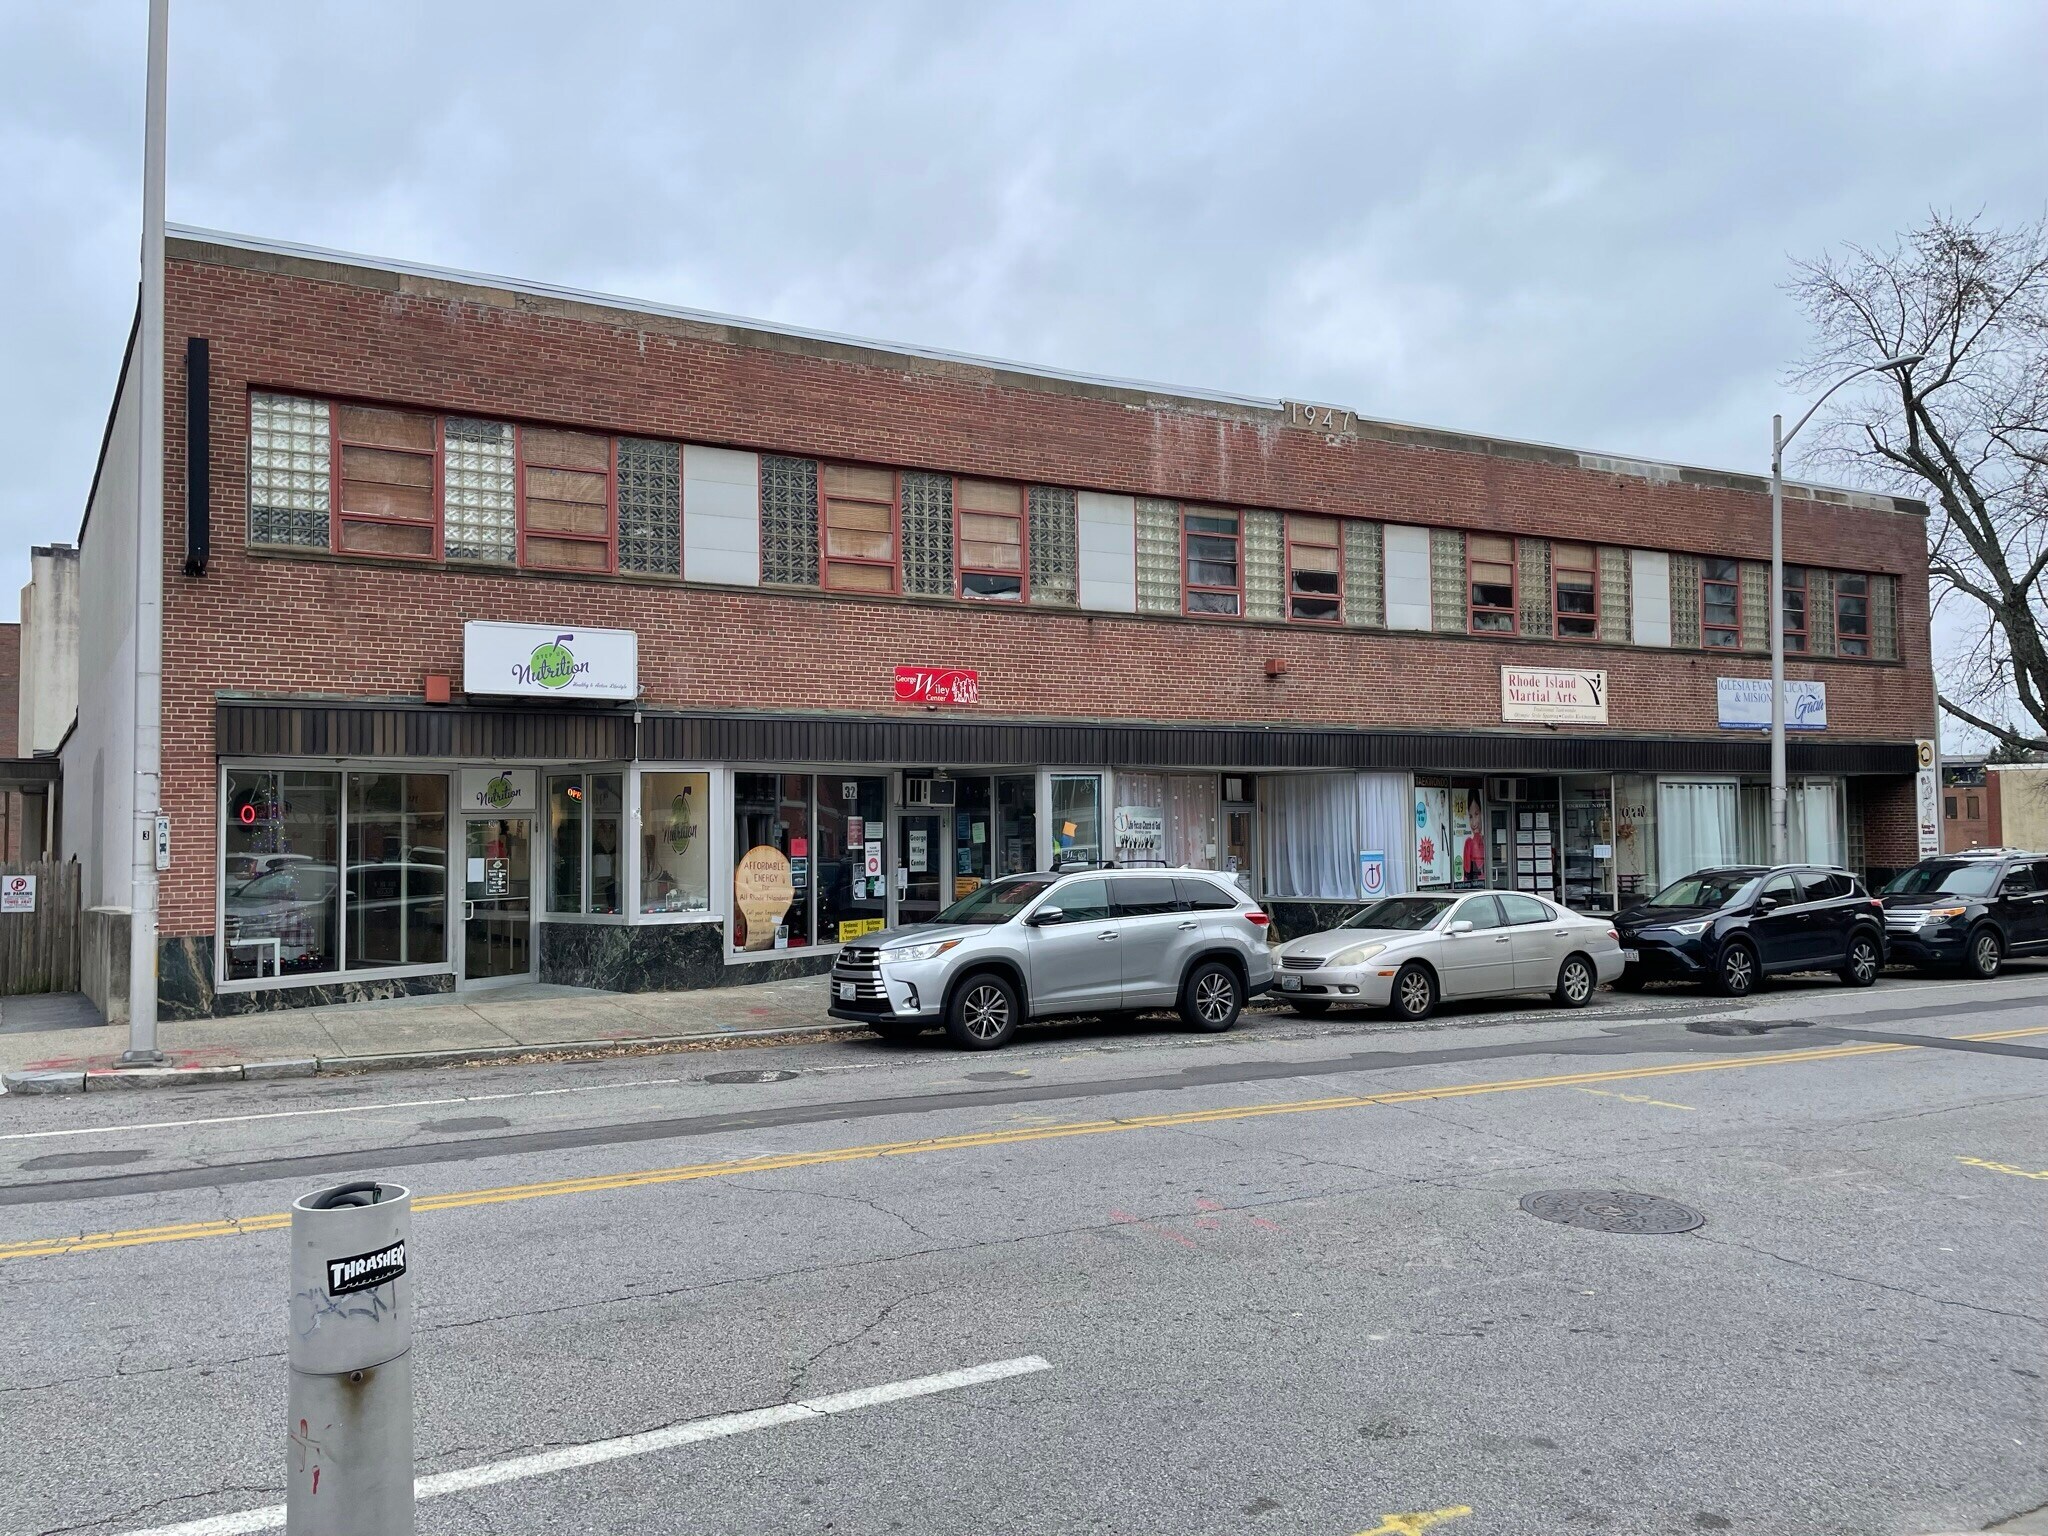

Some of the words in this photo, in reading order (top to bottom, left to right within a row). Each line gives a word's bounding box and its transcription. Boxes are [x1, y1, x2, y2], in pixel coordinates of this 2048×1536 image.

[1292, 403, 1350, 431] 1947
[511, 655, 589, 685] Nutrition
[895, 674, 917, 685] George
[915, 672, 950, 697] Wiley
[1508, 674, 1541, 688] Rhode
[1545, 675, 1576, 689] Island
[1718, 680, 1751, 691] IGLESIA
[926, 693, 947, 702] Center
[1508, 689, 1550, 703] Martial
[1554, 690, 1577, 703] Arts
[1734, 694, 1741, 702] &
[1794, 694, 1824, 723] Gracia
[1415, 776, 1448, 787] TAEKWONDO
[476, 785, 521, 806] Nutrition
[567, 787, 583, 800] OPE
[844, 786, 856, 799] 32
[1621, 804, 1647, 818] OPEN
[143, 831, 149, 840] 3
[662, 822, 697, 844] Nutrition
[910, 834, 927, 842] George
[911, 846, 925, 855] Wiley
[743, 861, 785, 871] AFFORDABLE
[910, 859, 926, 867] Center
[753, 873, 779, 882] ENERGY
[739, 893, 748, 901] All
[330, 1243, 405, 1289] THRASHER
